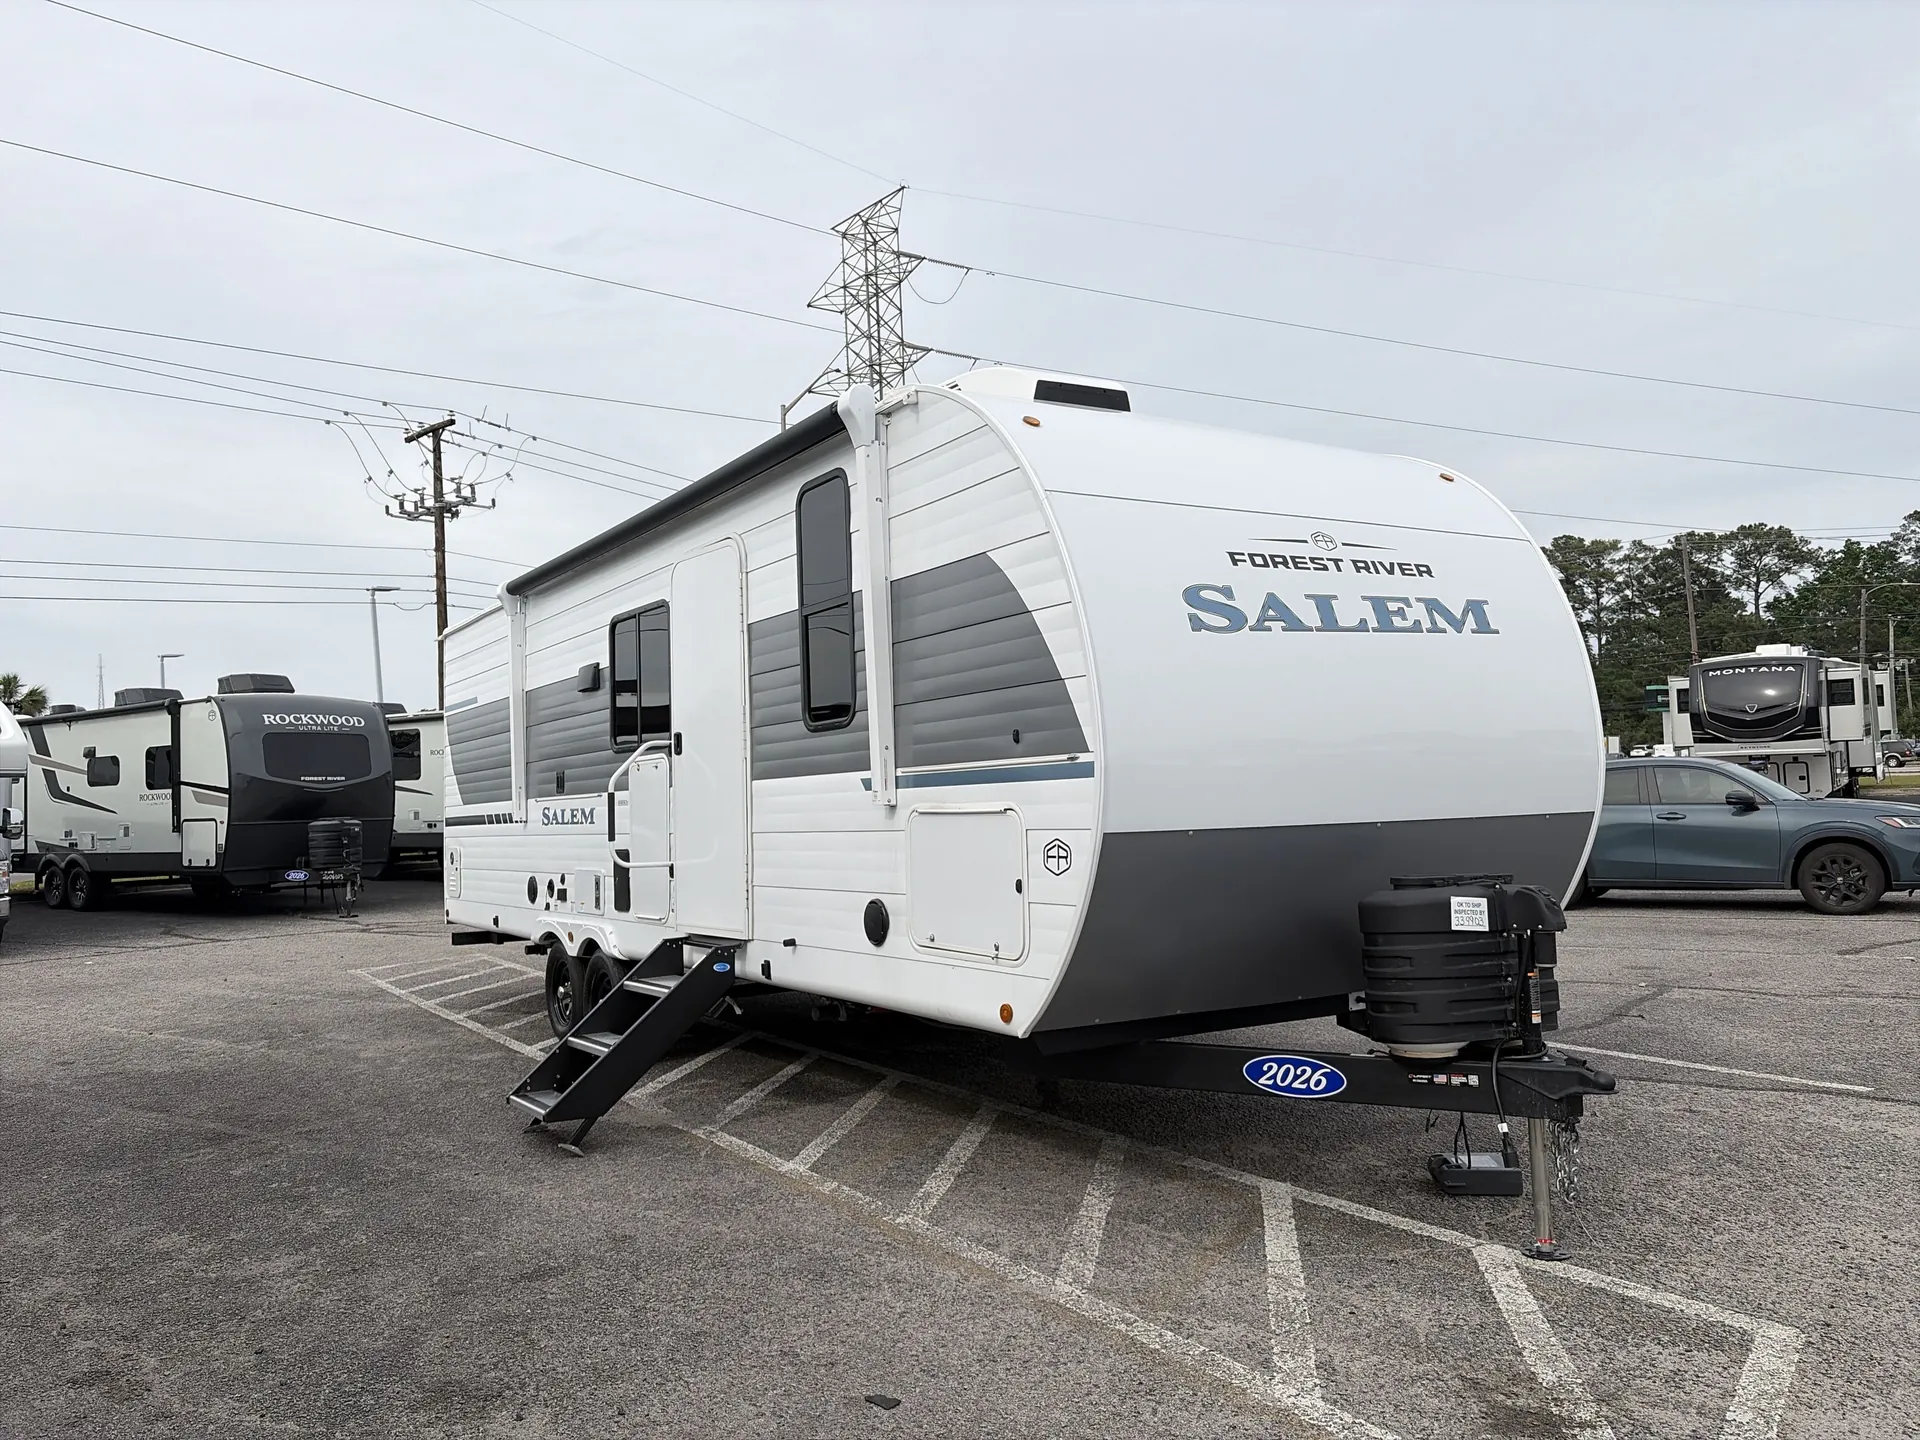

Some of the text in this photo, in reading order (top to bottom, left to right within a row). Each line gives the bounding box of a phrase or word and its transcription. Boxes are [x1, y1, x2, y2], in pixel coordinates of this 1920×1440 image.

[1226, 550, 1436, 579] FOREST RIVER
[1181, 583, 1501, 635] SALEM
[1708, 666, 1796, 677] MONTANA
[262, 713, 366, 727] ROCKWOOD
[139, 792, 173, 802] ROCKWOO
[541, 806, 596, 827] SALEM
[1257, 1062, 1332, 1092] 2026
